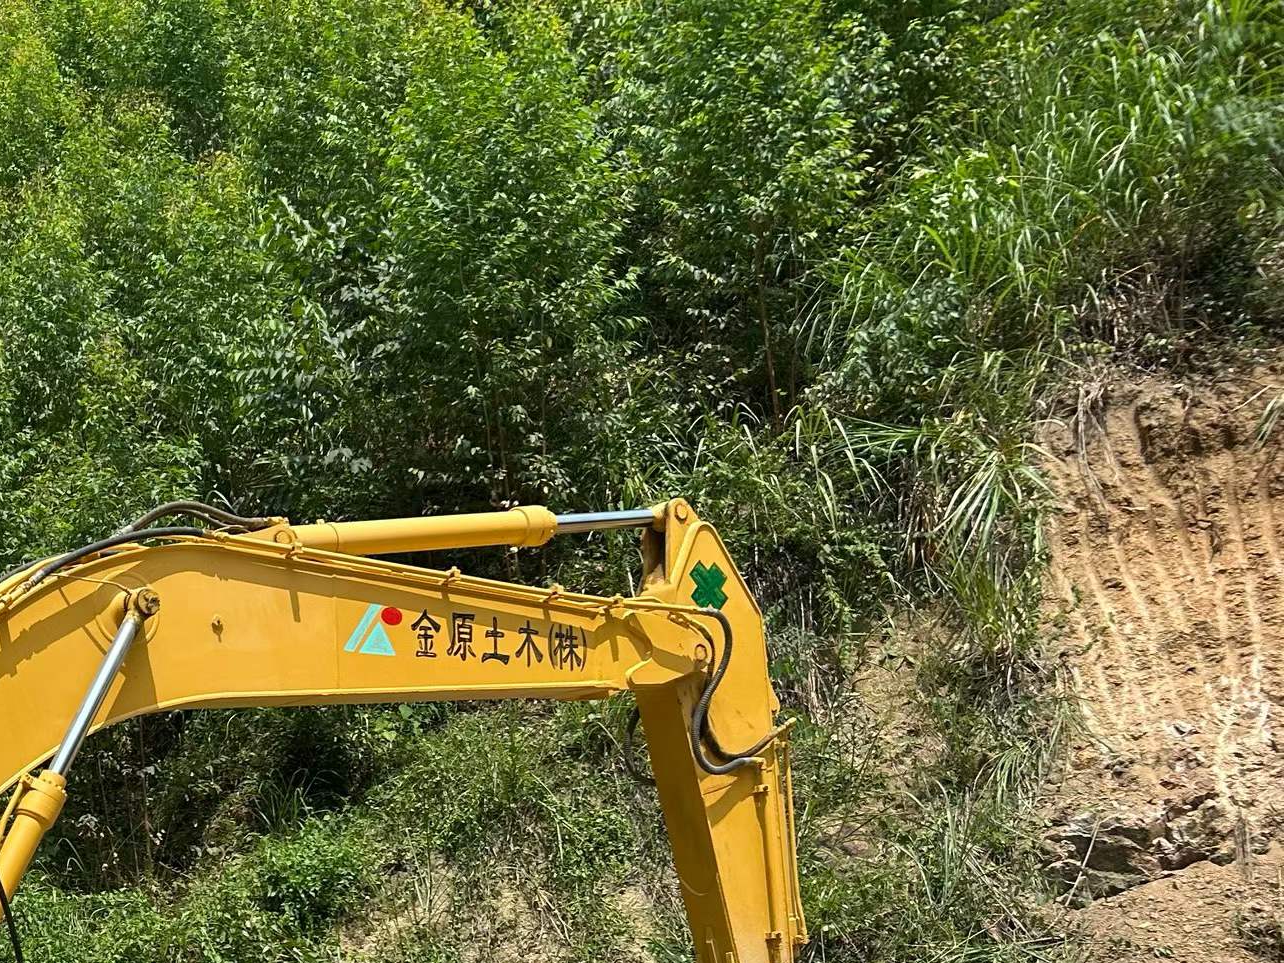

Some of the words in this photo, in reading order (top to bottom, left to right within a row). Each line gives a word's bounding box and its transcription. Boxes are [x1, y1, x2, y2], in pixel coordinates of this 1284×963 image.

[410, 608, 588, 672] 金原土木(株)
